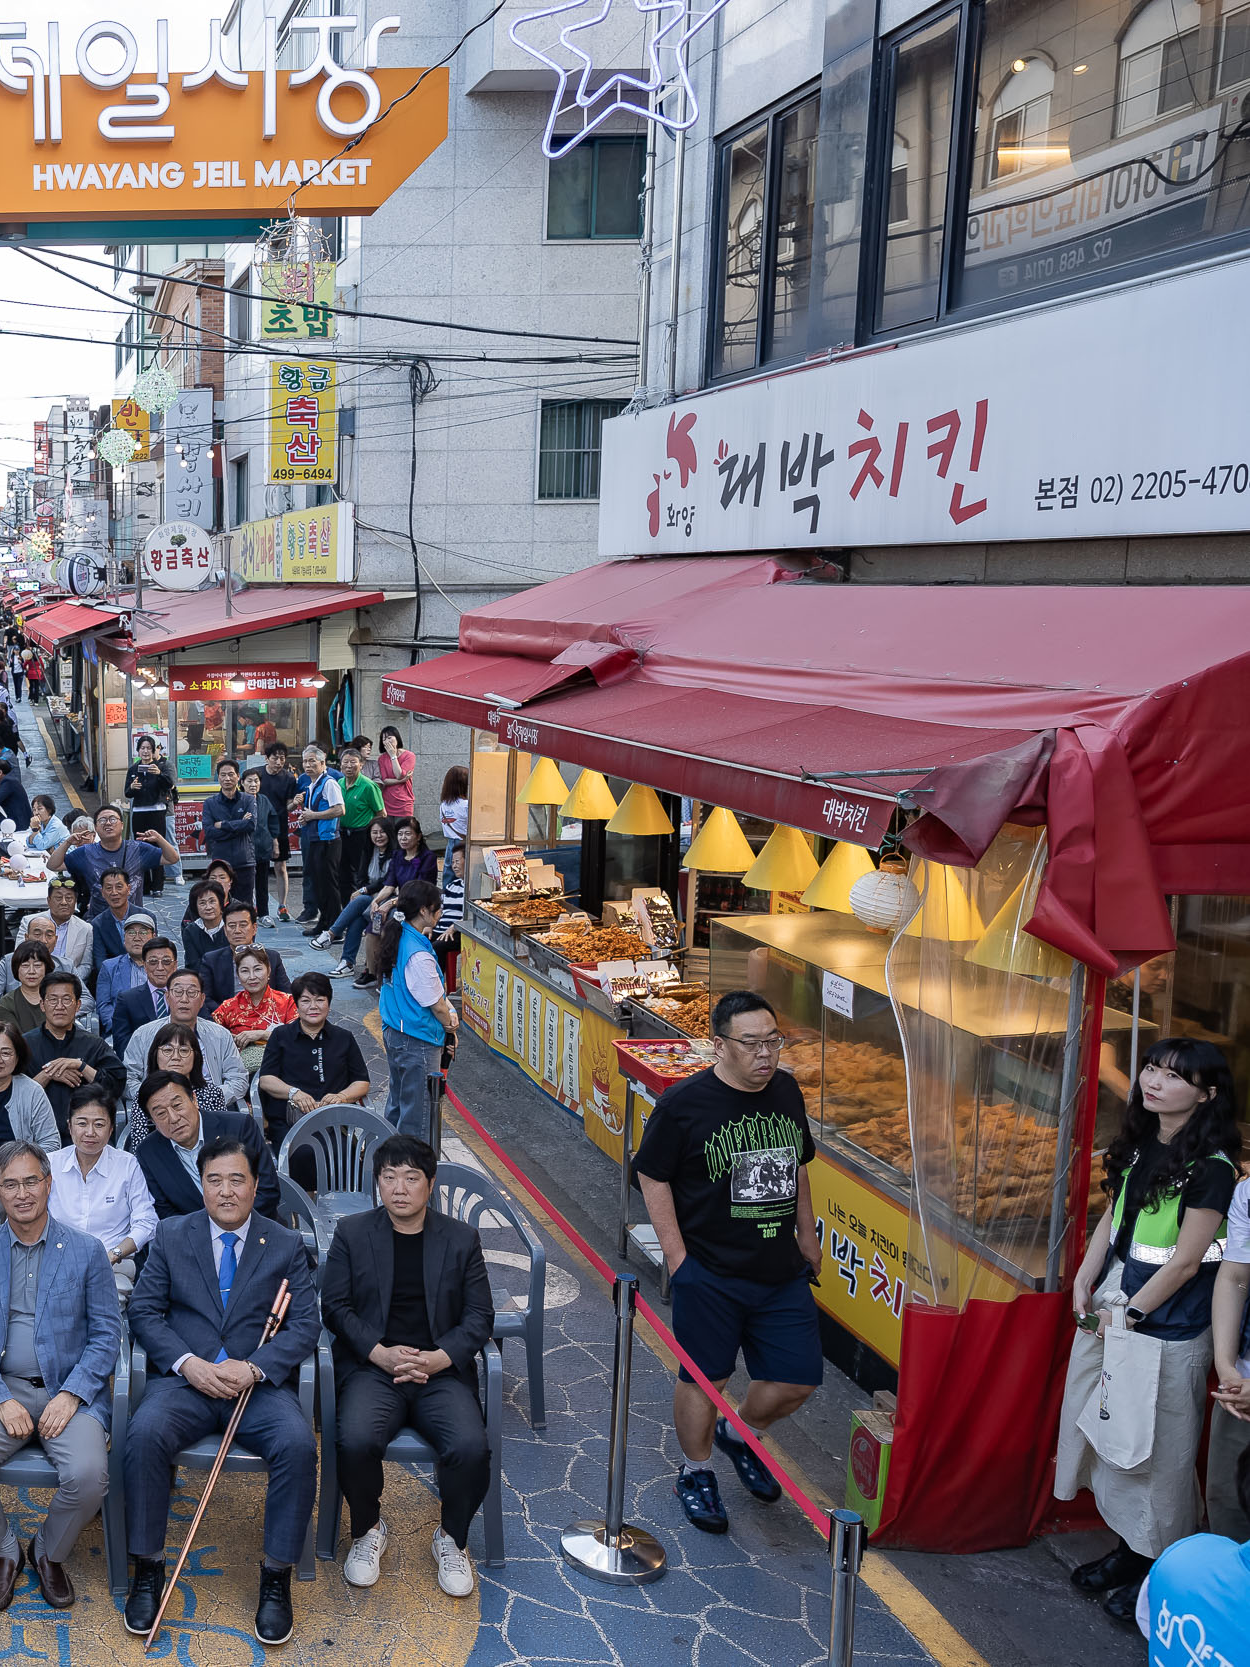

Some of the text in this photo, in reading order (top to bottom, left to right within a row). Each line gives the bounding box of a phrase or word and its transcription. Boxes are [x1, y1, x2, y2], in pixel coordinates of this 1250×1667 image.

[32, 158, 372, 191] HWAYANG JEIL MARKET
[263, 300, 333, 338] 초밥
[279, 364, 332, 392] 황금
[286, 395, 321, 466] 축산
[272, 467, 332, 481] 499-6494
[1033, 462, 1250, 512] 본점 02) 2205-470
[665, 505, 696, 538] 화양
[150, 547, 210, 572] 황금축산
[247, 677, 297, 690] 판매합니다
[822, 798, 870, 833] 대박치킨
[762, 1228, 777, 1239] 2023
[827, 1198, 846, 1225] 나는
[847, 1213, 868, 1241] 오늘
[869, 1228, 899, 1262] 치킨이
